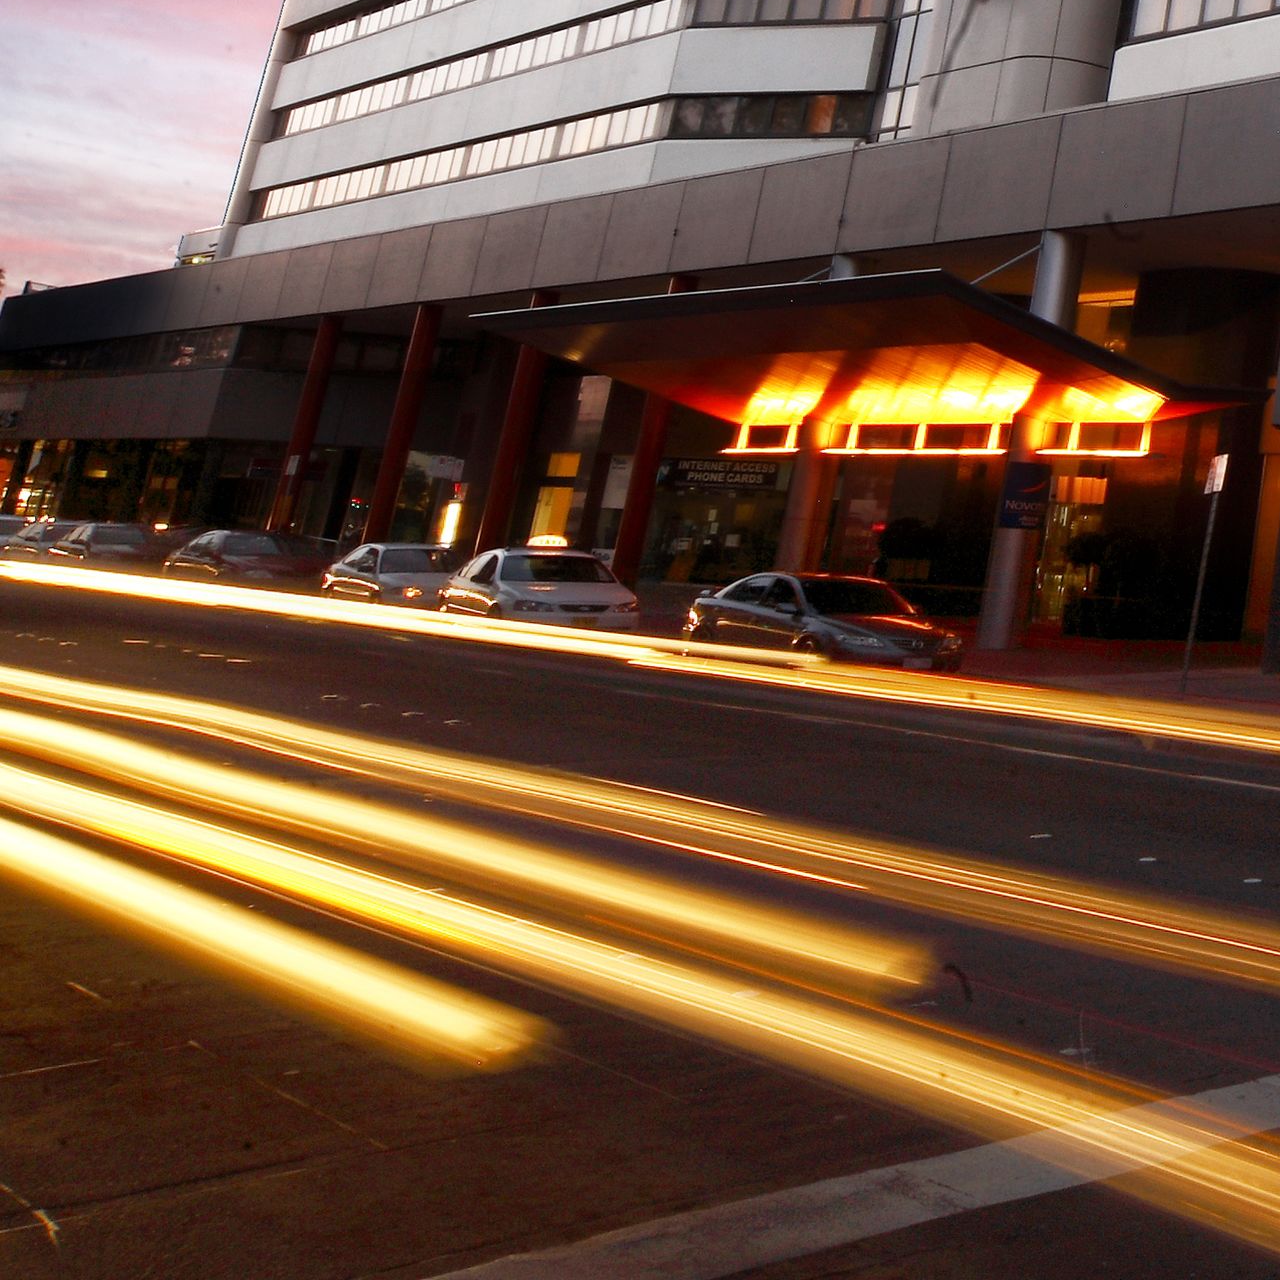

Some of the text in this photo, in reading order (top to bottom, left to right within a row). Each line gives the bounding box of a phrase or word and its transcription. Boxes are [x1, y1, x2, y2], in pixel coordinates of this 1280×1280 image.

[678, 459, 777, 473] INTERNET ACCESS
[687, 471, 764, 484] PHONE CARDS
